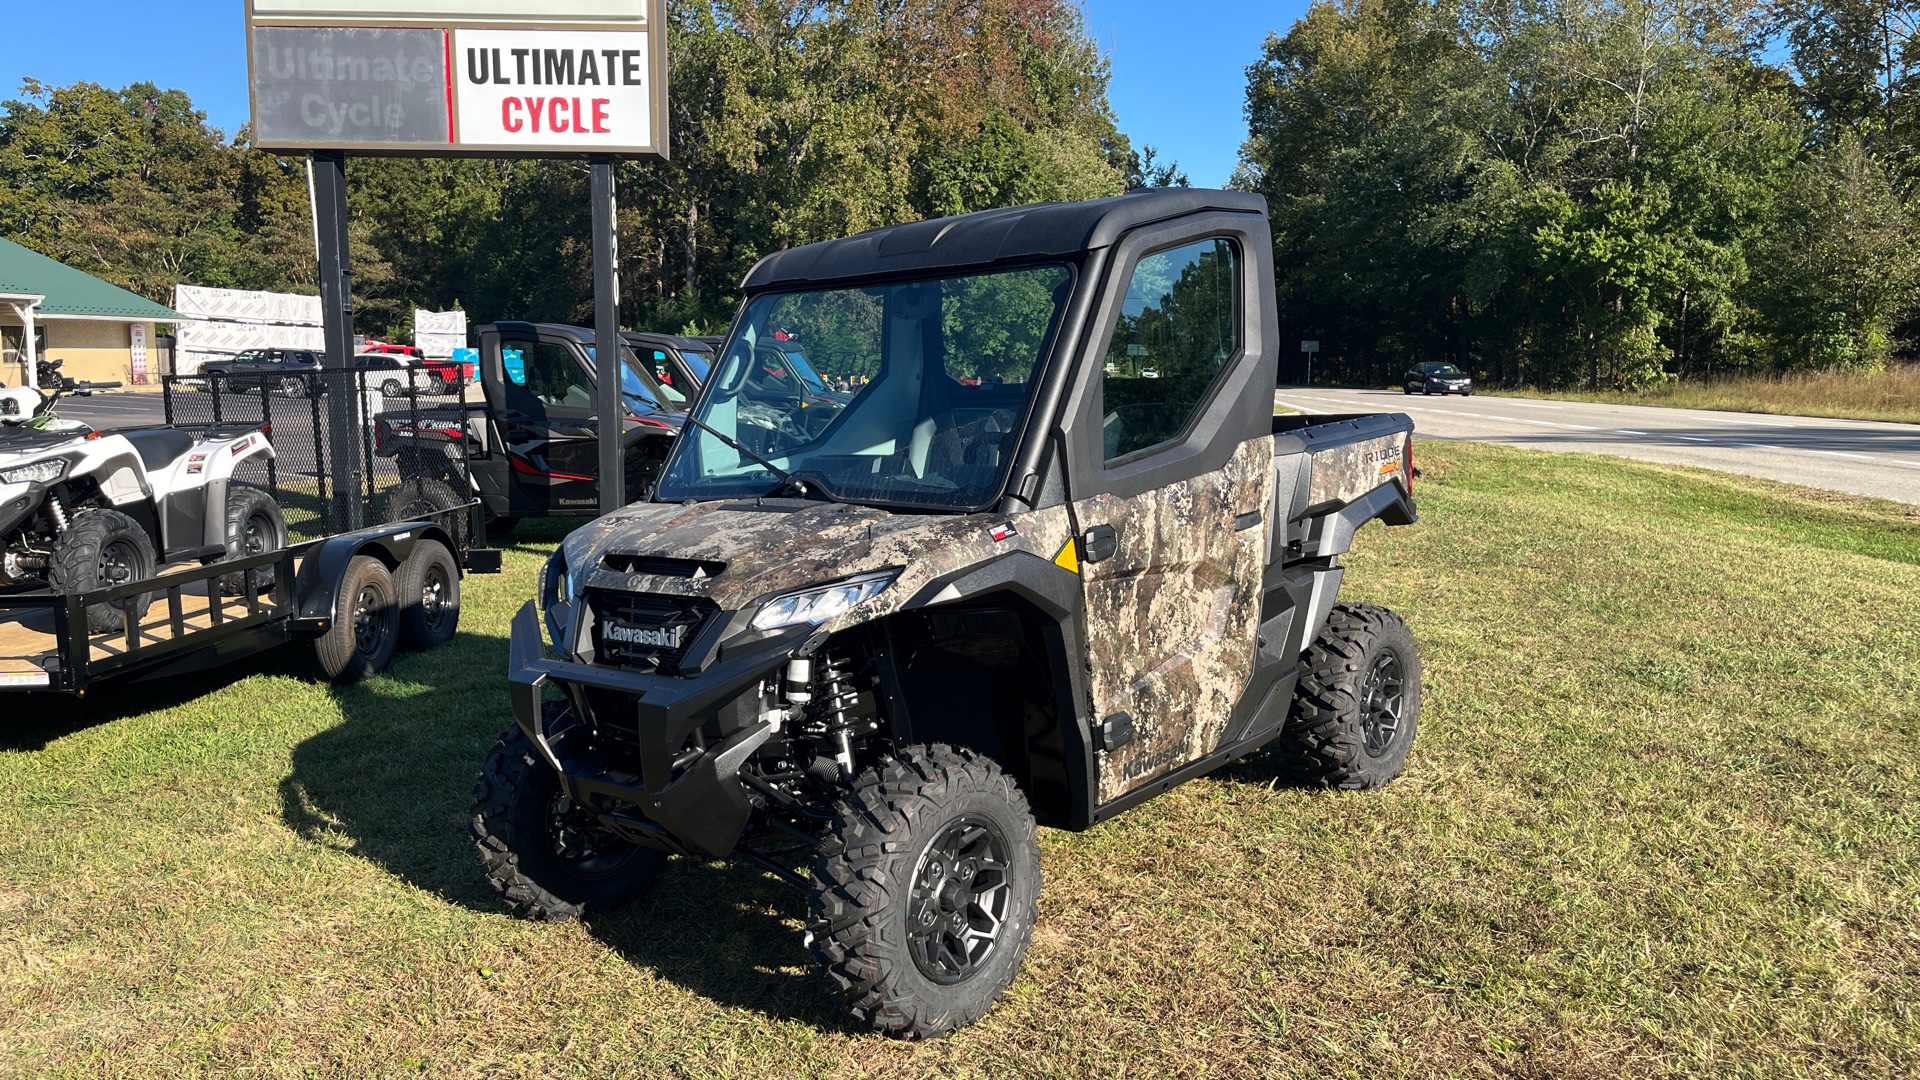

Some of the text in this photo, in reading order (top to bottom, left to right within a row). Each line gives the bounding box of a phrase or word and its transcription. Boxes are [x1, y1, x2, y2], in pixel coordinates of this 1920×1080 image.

[267, 46, 434, 83] Ultimate
[467, 48, 641, 86] ULTIMATE
[300, 94, 407, 135] Cycle
[502, 96, 611, 134] CYCLE
[1365, 445, 1400, 464] RIDGE
[558, 497, 598, 505] Kawasaki
[603, 620, 676, 648] Kawasaki
[1122, 740, 1190, 782] Kawasaki
